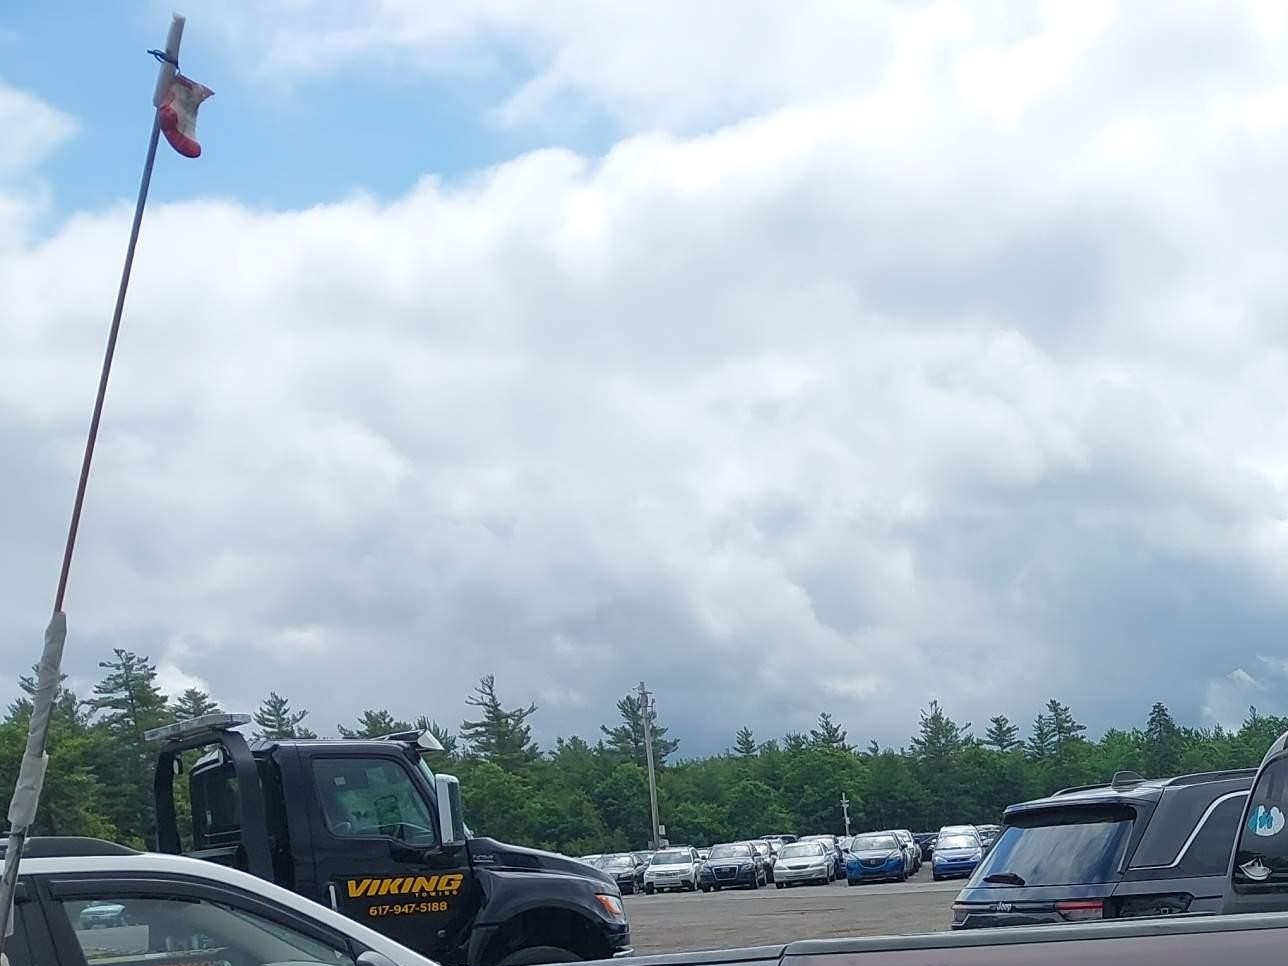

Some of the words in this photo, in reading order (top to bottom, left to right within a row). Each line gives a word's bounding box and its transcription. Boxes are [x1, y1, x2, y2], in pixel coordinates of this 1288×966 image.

[347, 874, 464, 898] VIKING
[415, 890, 458, 898] TOWING
[368, 901, 448, 917] 617-947-5188
